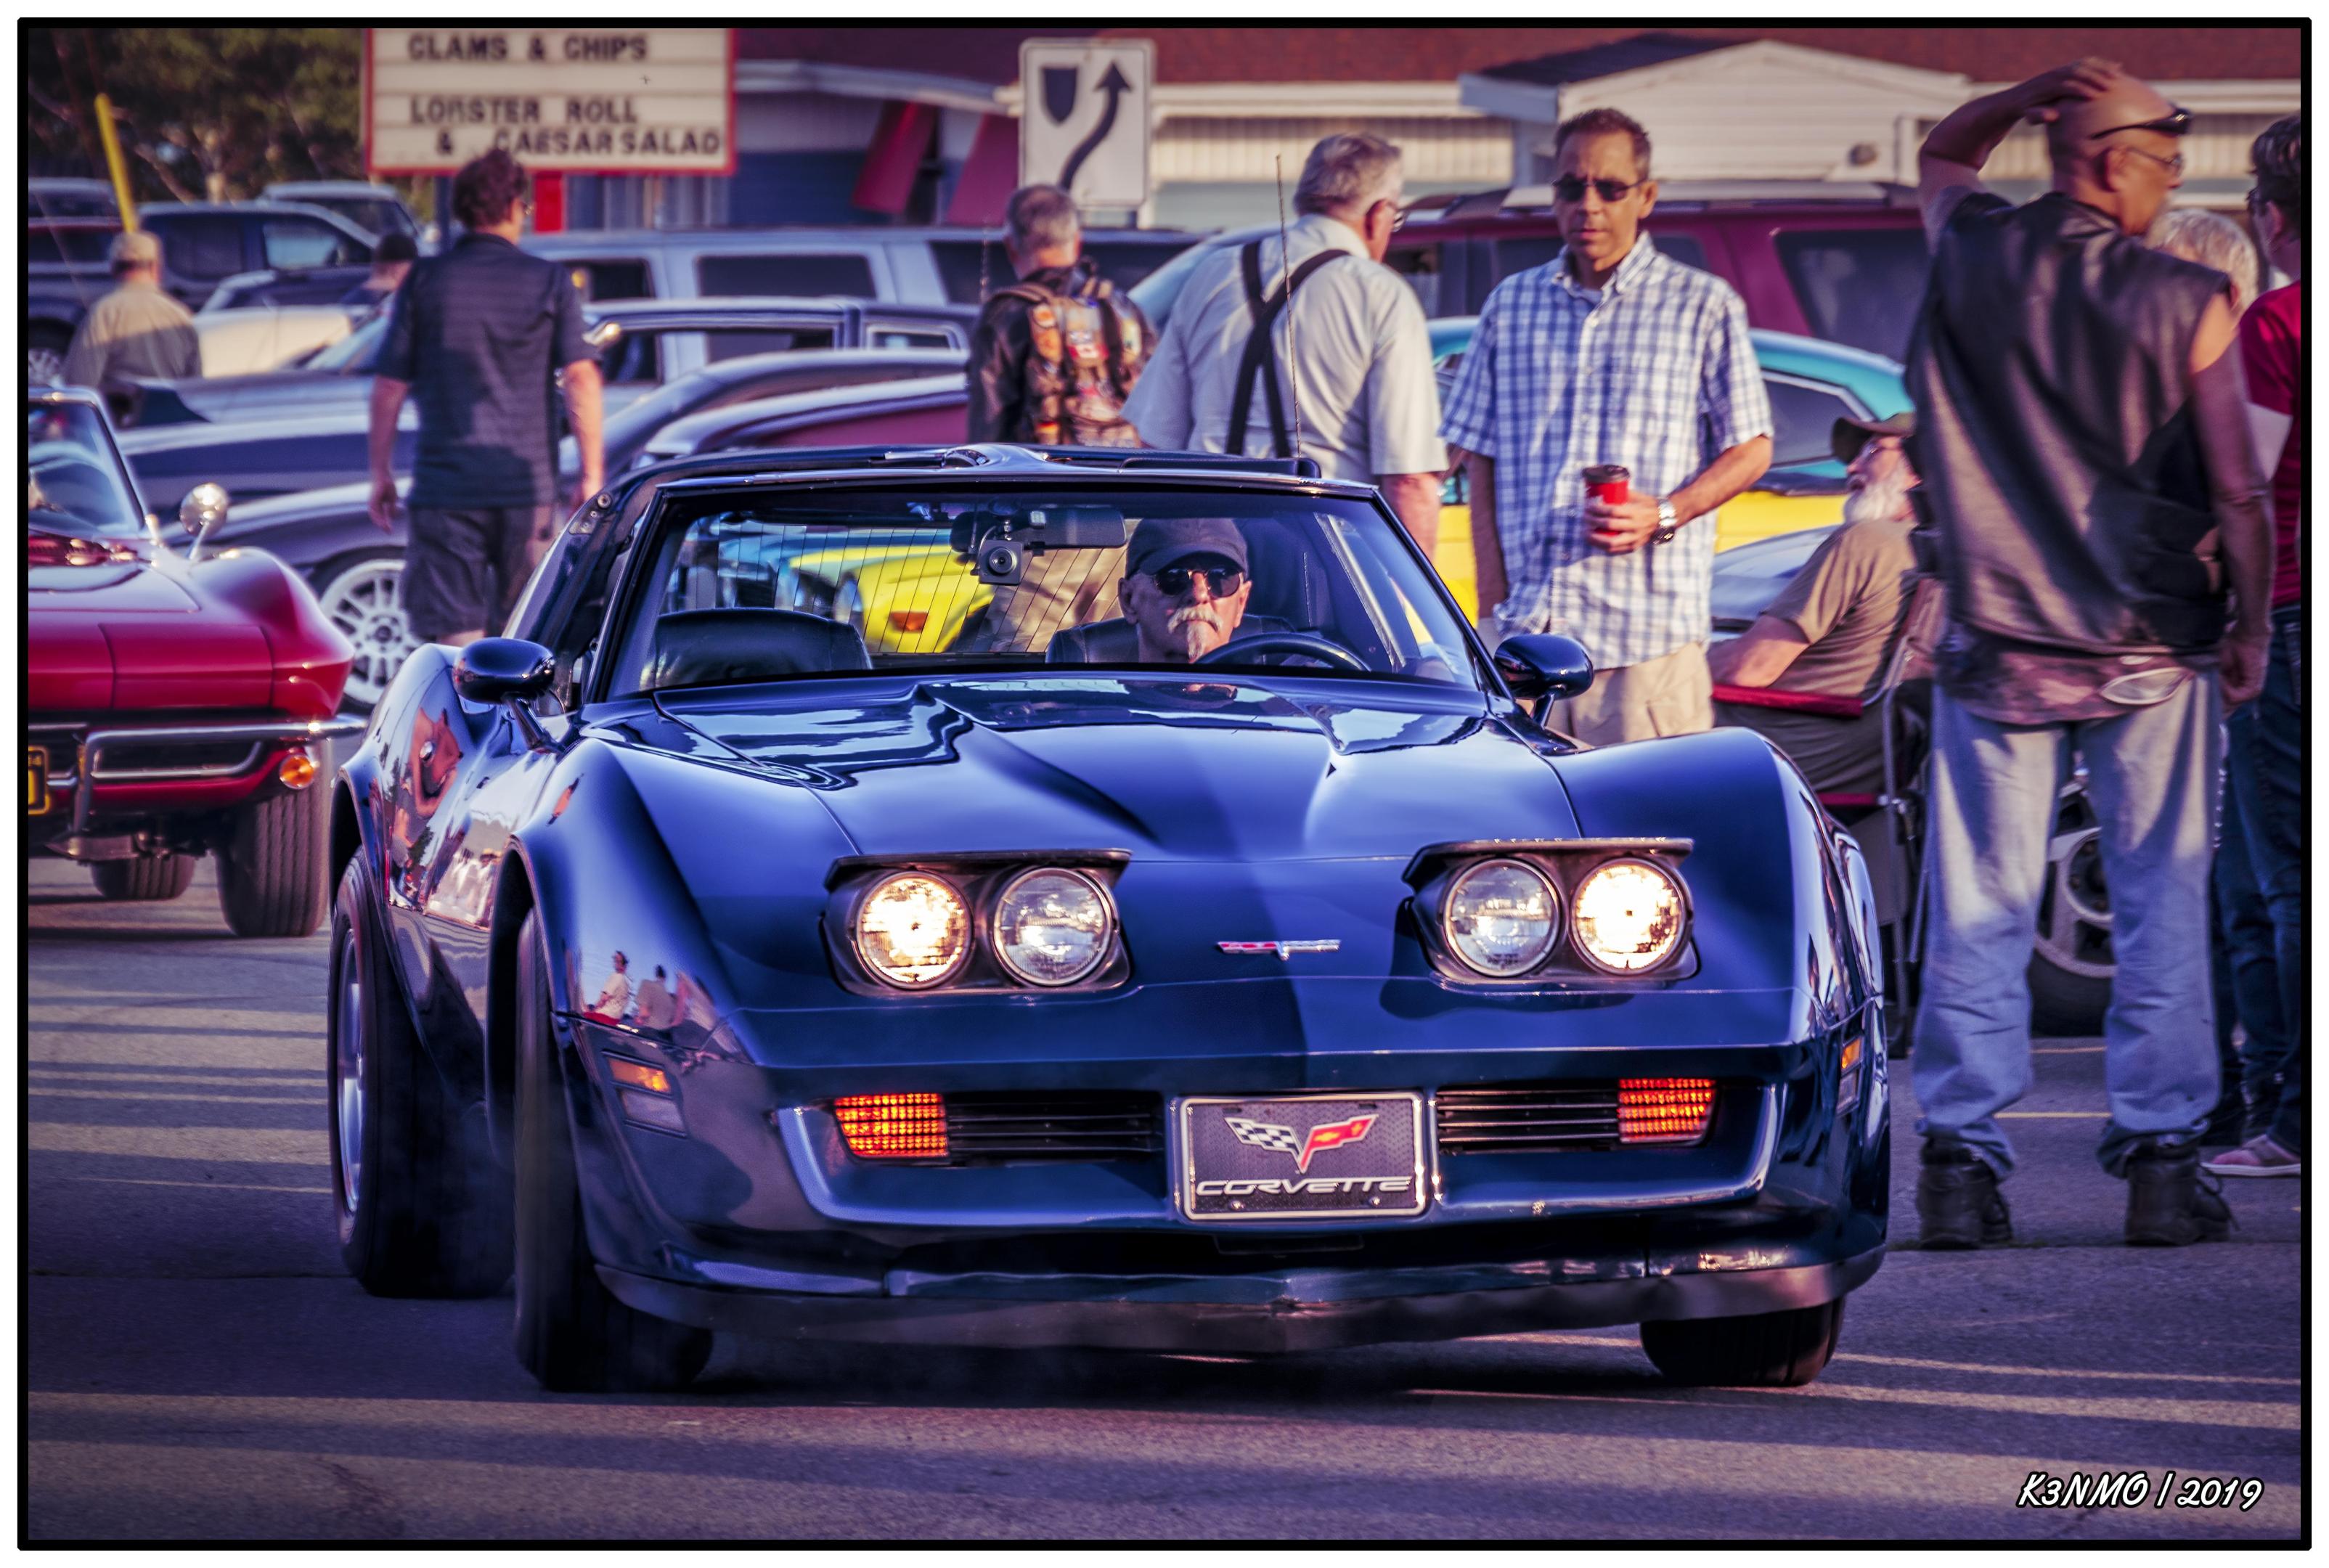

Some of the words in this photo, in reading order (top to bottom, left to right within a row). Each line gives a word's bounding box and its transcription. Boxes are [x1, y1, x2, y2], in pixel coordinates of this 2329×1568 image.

[407, 33, 507, 60] CLAMS
[527, 34, 545, 60] &
[563, 33, 647, 60] CHIPS
[566, 97, 637, 123] ROLL
[437, 129, 453, 155] &
[620, 131, 720, 155] SALAD
[1196, 1176, 1412, 1196] CORVETTE
